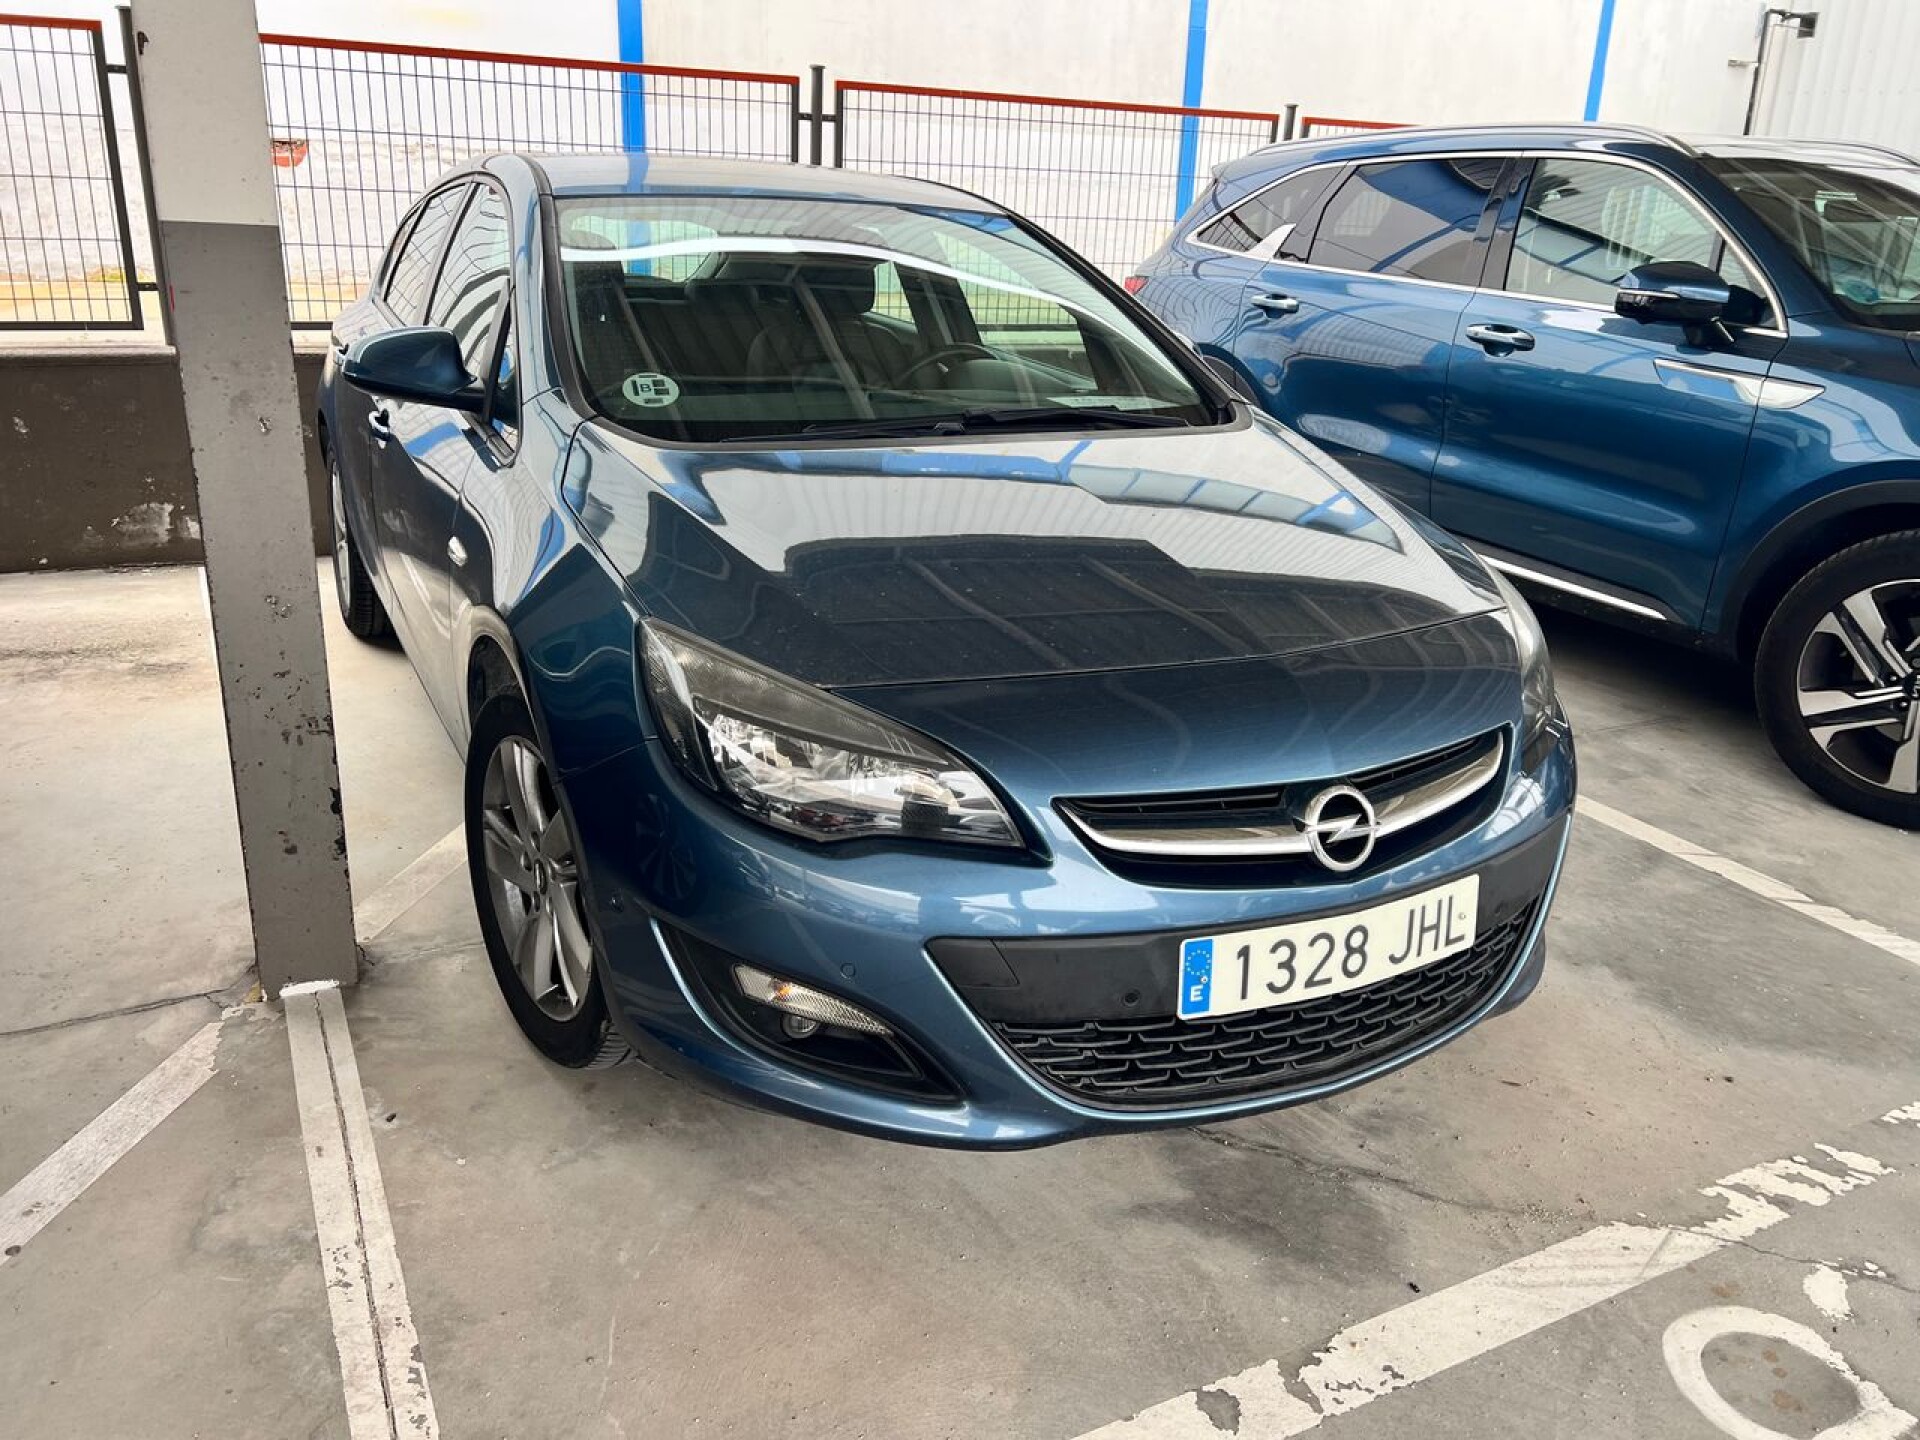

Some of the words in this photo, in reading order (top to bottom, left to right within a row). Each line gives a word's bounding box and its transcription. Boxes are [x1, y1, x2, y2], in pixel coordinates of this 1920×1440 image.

[639, 383, 652, 393] B
[1236, 924, 1369, 1001] 1328
[1388, 895, 1465, 965] JHL
[1190, 984, 1204, 1003] E
